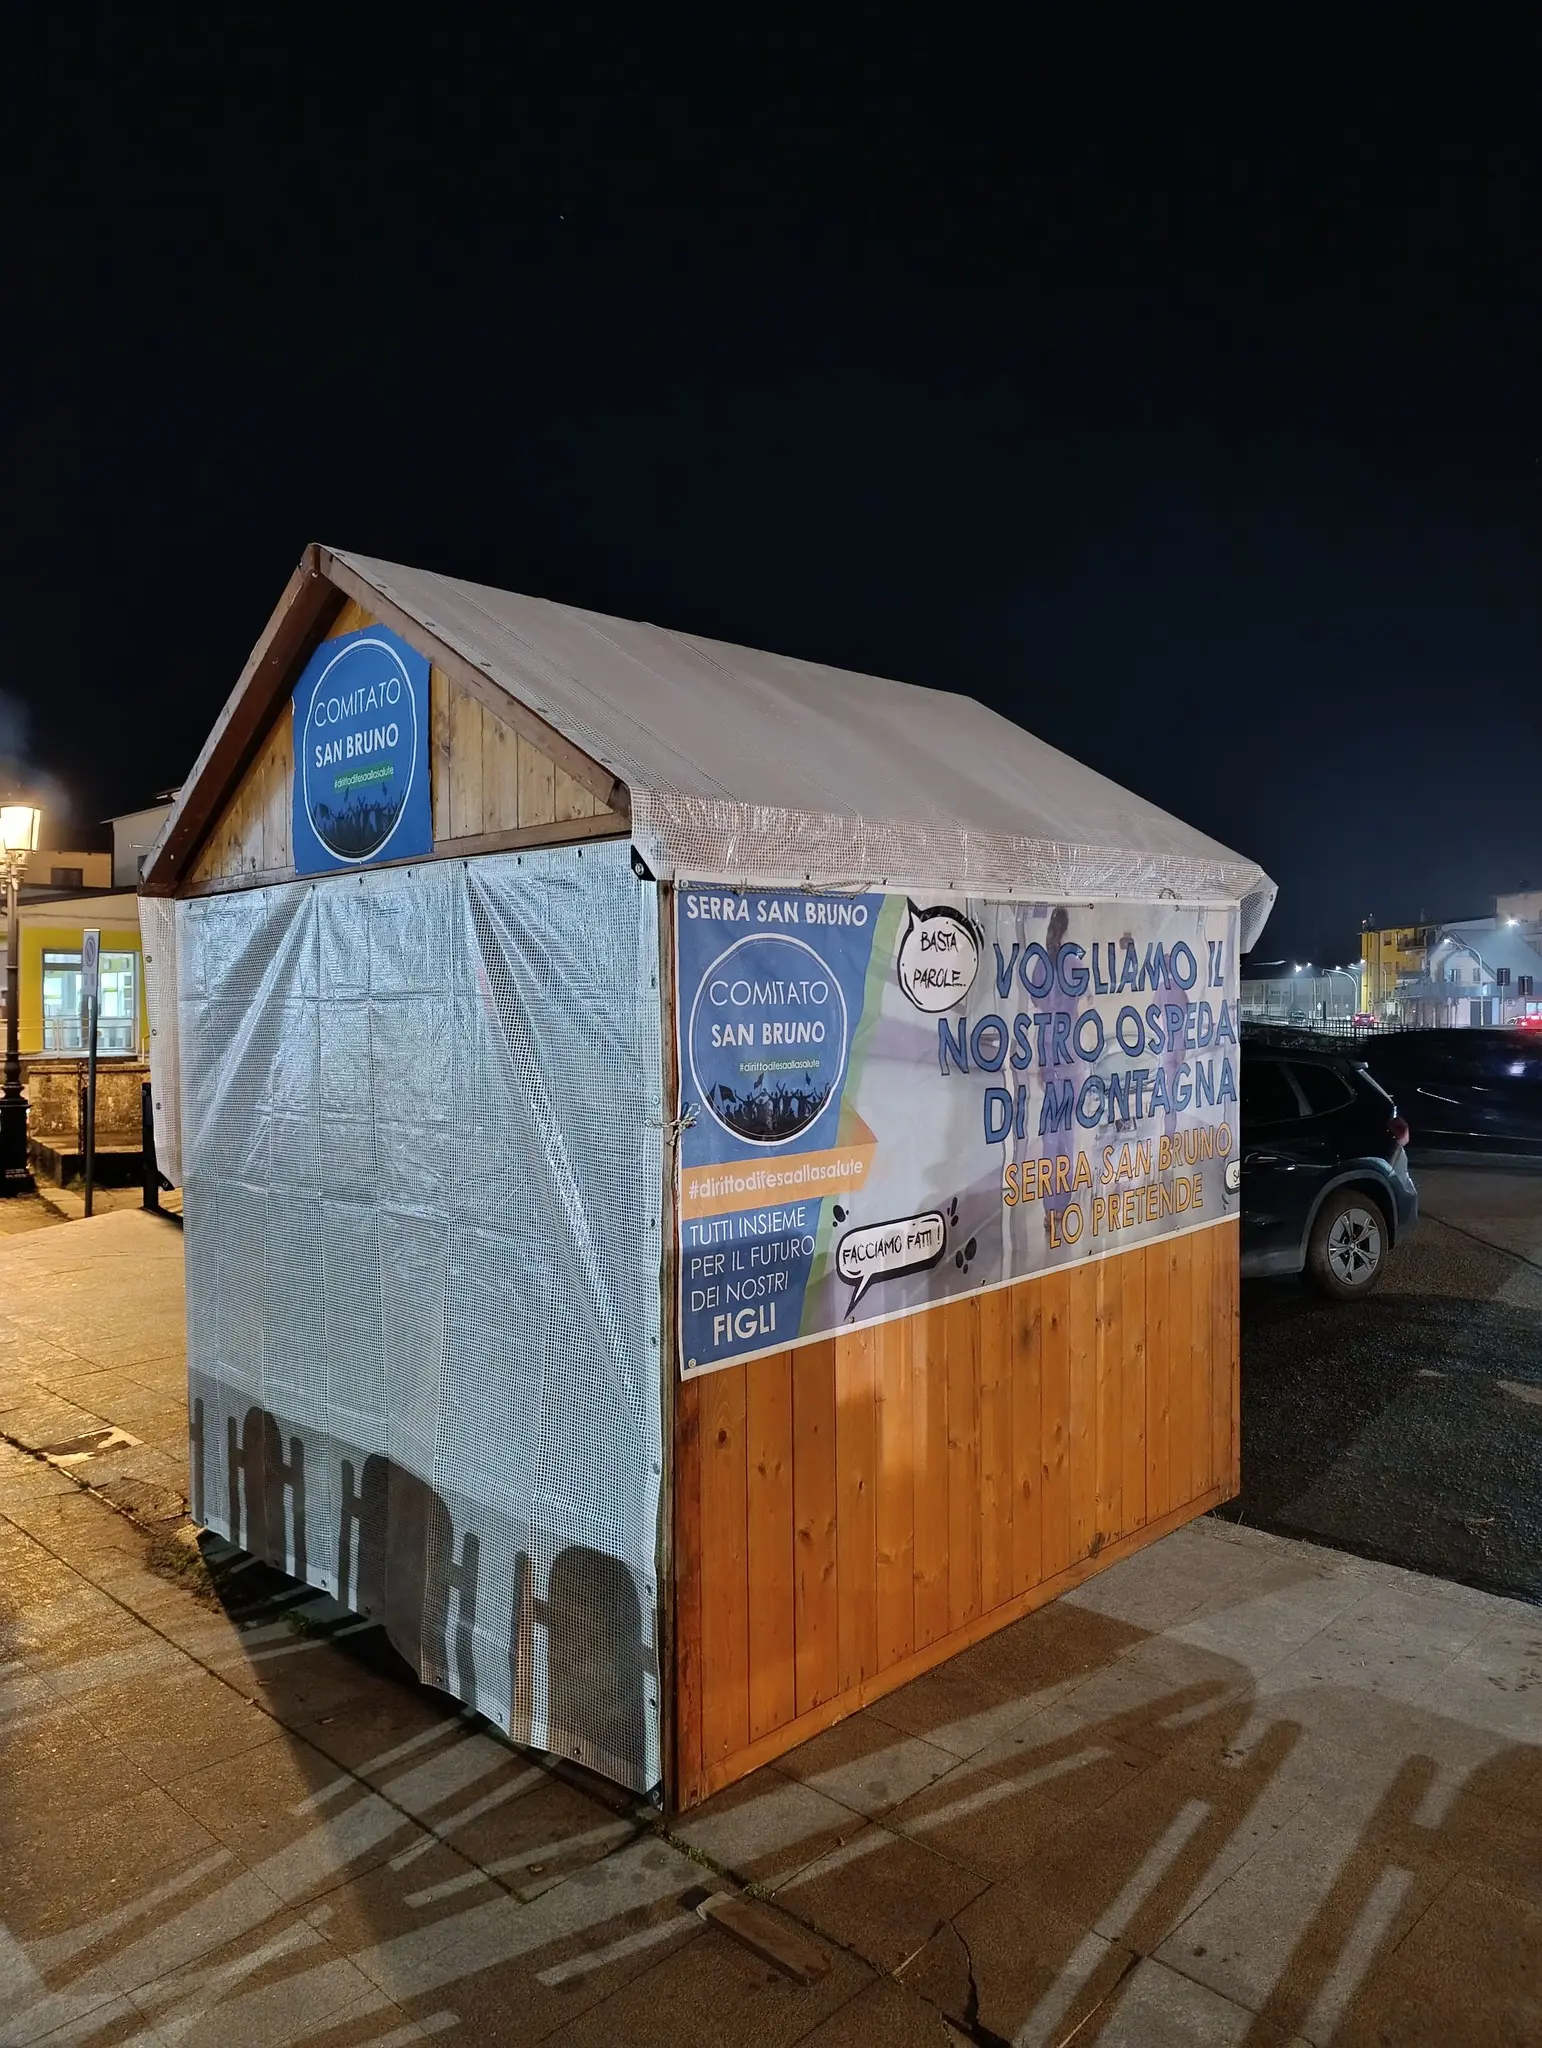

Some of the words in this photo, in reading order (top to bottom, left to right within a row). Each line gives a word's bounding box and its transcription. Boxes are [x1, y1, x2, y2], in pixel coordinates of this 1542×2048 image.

[314, 677, 401, 727] COMITATO
[315, 738, 342, 768] SAN
[346, 722, 399, 759] BRUNO
[686, 894, 750, 921] SERRA
[757, 900, 798, 923] SAN
[804, 902, 868, 926] BRUNO
[920, 930, 959, 952] BASTA
[993, 940, 1198, 999] VOGLIAMO
[1208, 940, 1224, 988] IL
[709, 980, 829, 1006] COMITATO
[711, 1023, 754, 1047] SAN
[762, 1020, 825, 1045] BRUNO
[938, 1008, 1105, 1076] NOSTRO
[984, 1084, 1027, 1145] DI
[1038, 1057, 1238, 1137] MONTAGNA
[689, 1159, 863, 1200] #dirittodifesaallasalute
[1003, 1151, 1093, 1207] SERRA
[1099, 1138, 1151, 1185] SAN
[1158, 1122, 1233, 1172] BRUNO
[690, 1220, 733, 1247] TUTTI
[739, 1206, 806, 1236] INSIEME
[1050, 1203, 1084, 1249] LO
[1092, 1173, 1203, 1237] PRETENDE
[691, 1253, 725, 1279] PER
[732, 1247, 745, 1271] IL
[750, 1234, 815, 1267] FUTURO
[842, 1235, 902, 1266] FACCIAMO
[691, 1288, 719, 1313] DEI
[726, 1270, 789, 1304] NOSTRI
[713, 1302, 776, 1346] FIGLI
